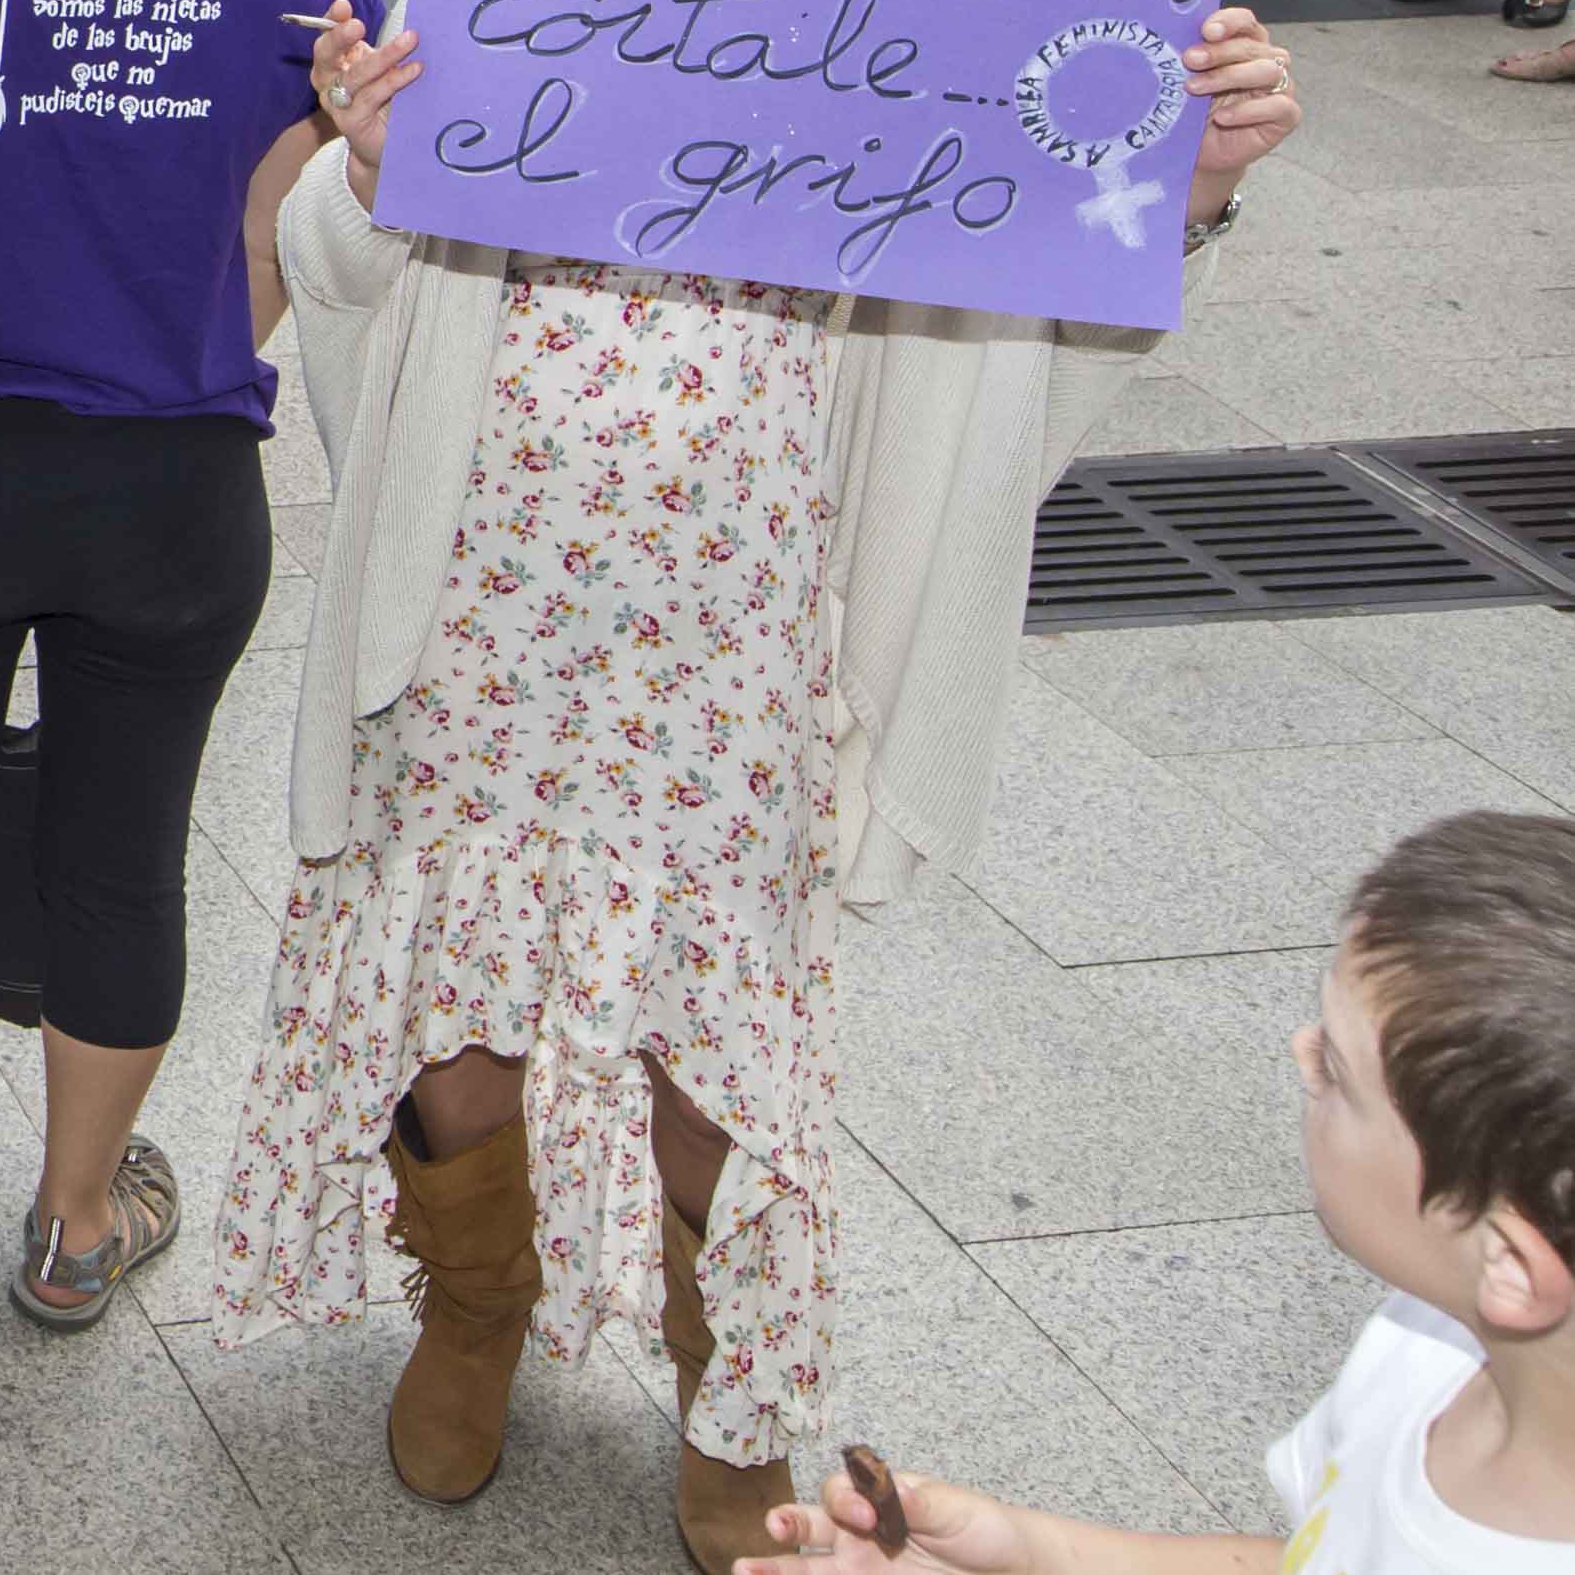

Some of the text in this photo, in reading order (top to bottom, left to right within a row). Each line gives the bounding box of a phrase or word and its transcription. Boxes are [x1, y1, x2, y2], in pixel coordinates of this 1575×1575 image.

[52, 21, 193, 66] de las brujas
[1037, 19, 1167, 70] FEMINISTA
[126, 65, 155, 86] no
[19, 86, 115, 126] pudisteis
[434, 77, 1017, 276] el grifo
